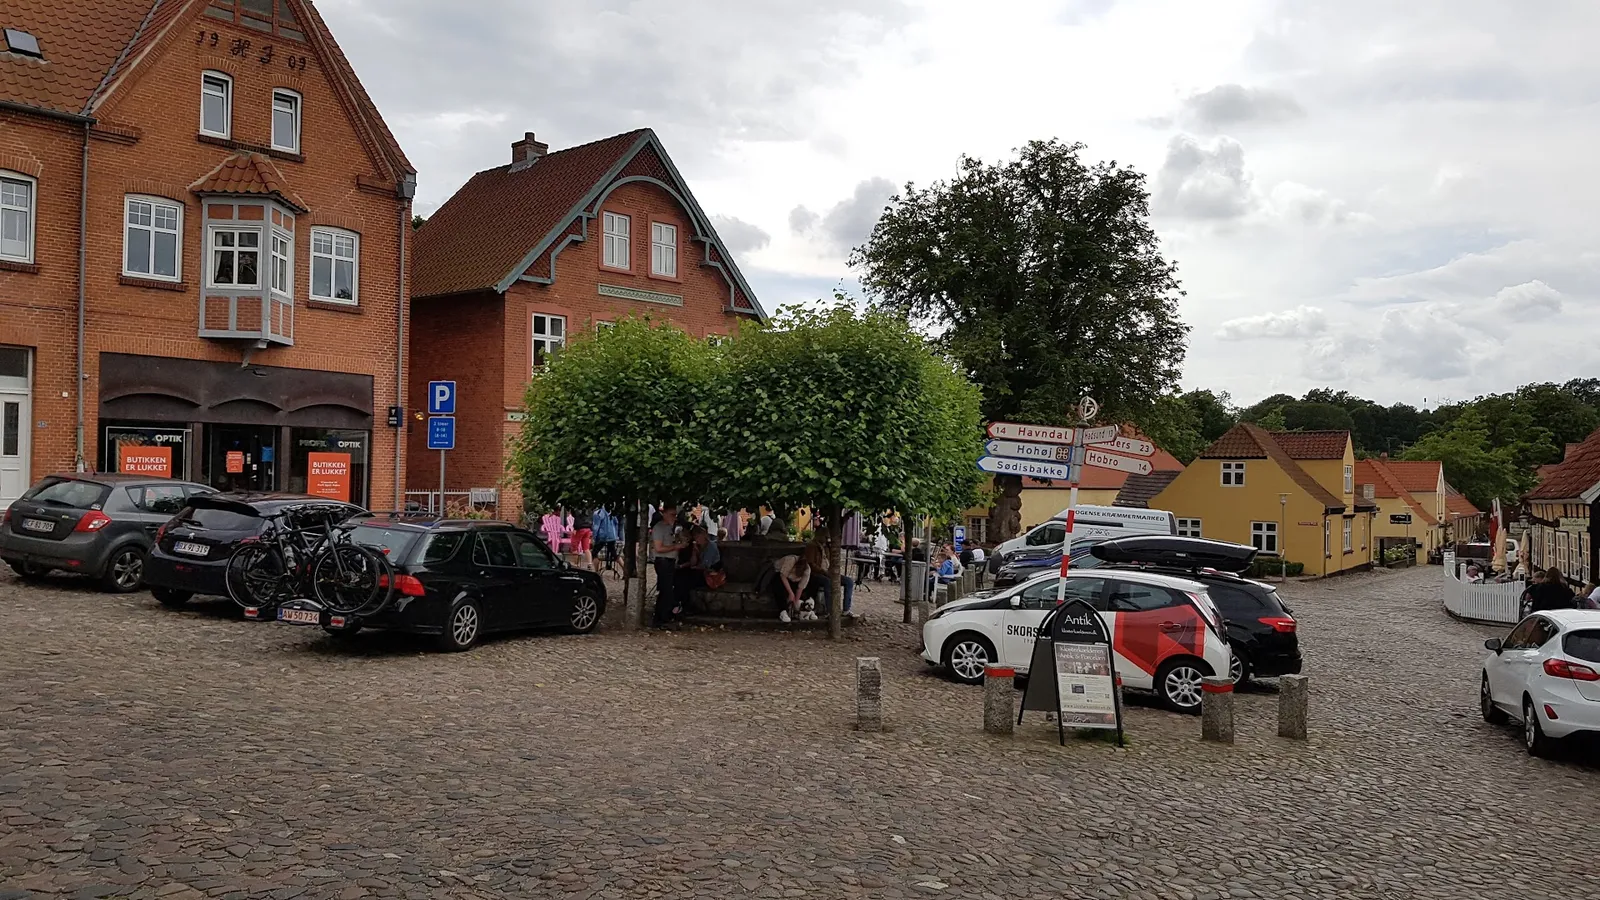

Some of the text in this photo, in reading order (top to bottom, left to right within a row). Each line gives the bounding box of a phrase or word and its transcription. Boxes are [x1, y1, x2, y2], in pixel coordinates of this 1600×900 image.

[435, 385, 450, 410] P
[155, 434, 182, 442] OPTIK
[1018, 427, 1068, 439] Havndal
[1017, 445, 1053, 458] Hohøj
[1140, 444, 1149, 453] 23
[997, 461, 1062, 475] Sødisbakke
[1089, 452, 1147, 471] Hobro 14
[1075, 509, 1165, 522] OGENSE KRÆMMERMARKED
[283, 610, 318, 622] AW 50 734
[1064, 613, 1093, 626] Antik
